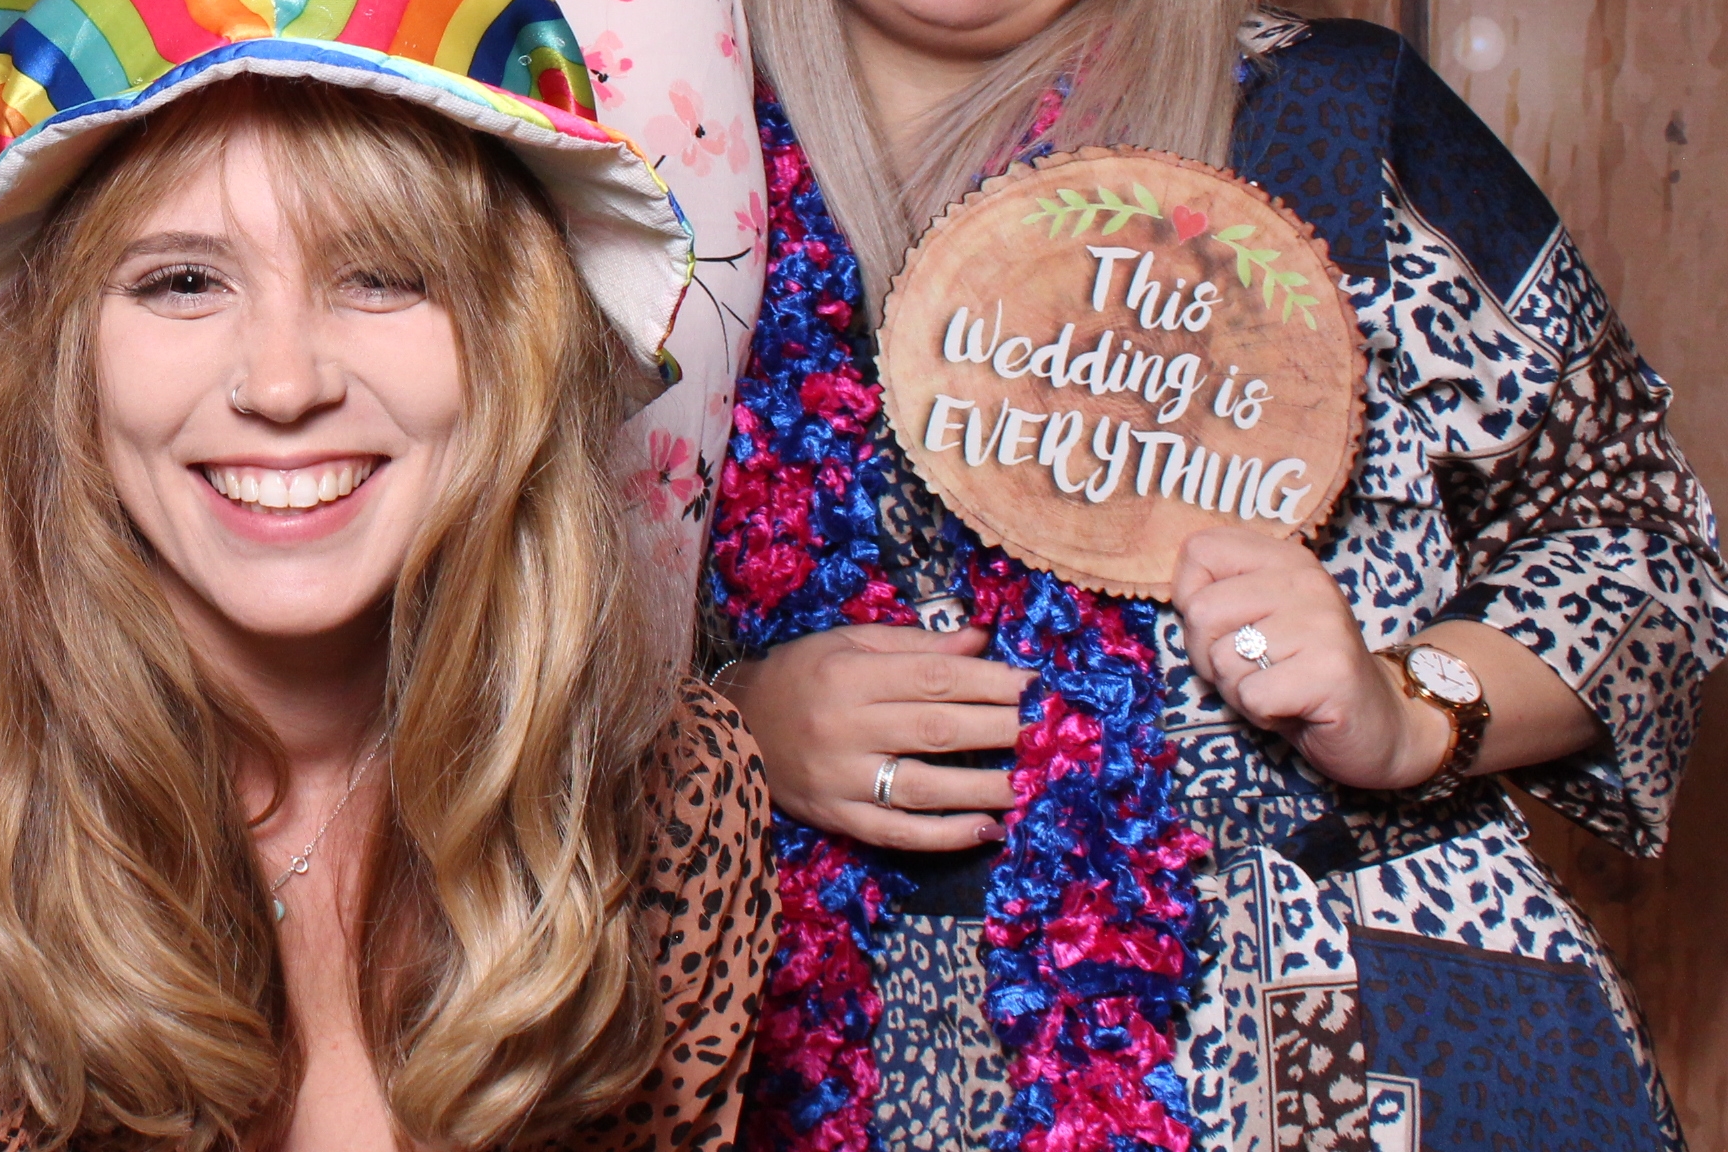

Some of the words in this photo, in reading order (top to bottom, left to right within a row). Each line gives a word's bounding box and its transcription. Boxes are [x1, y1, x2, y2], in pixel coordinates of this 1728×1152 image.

[1087, 244, 1224, 332] This
[943, 299, 1207, 424] Wedding
[1213, 364, 1274, 430] is
[924, 394, 1312, 524] EVERYTHING
